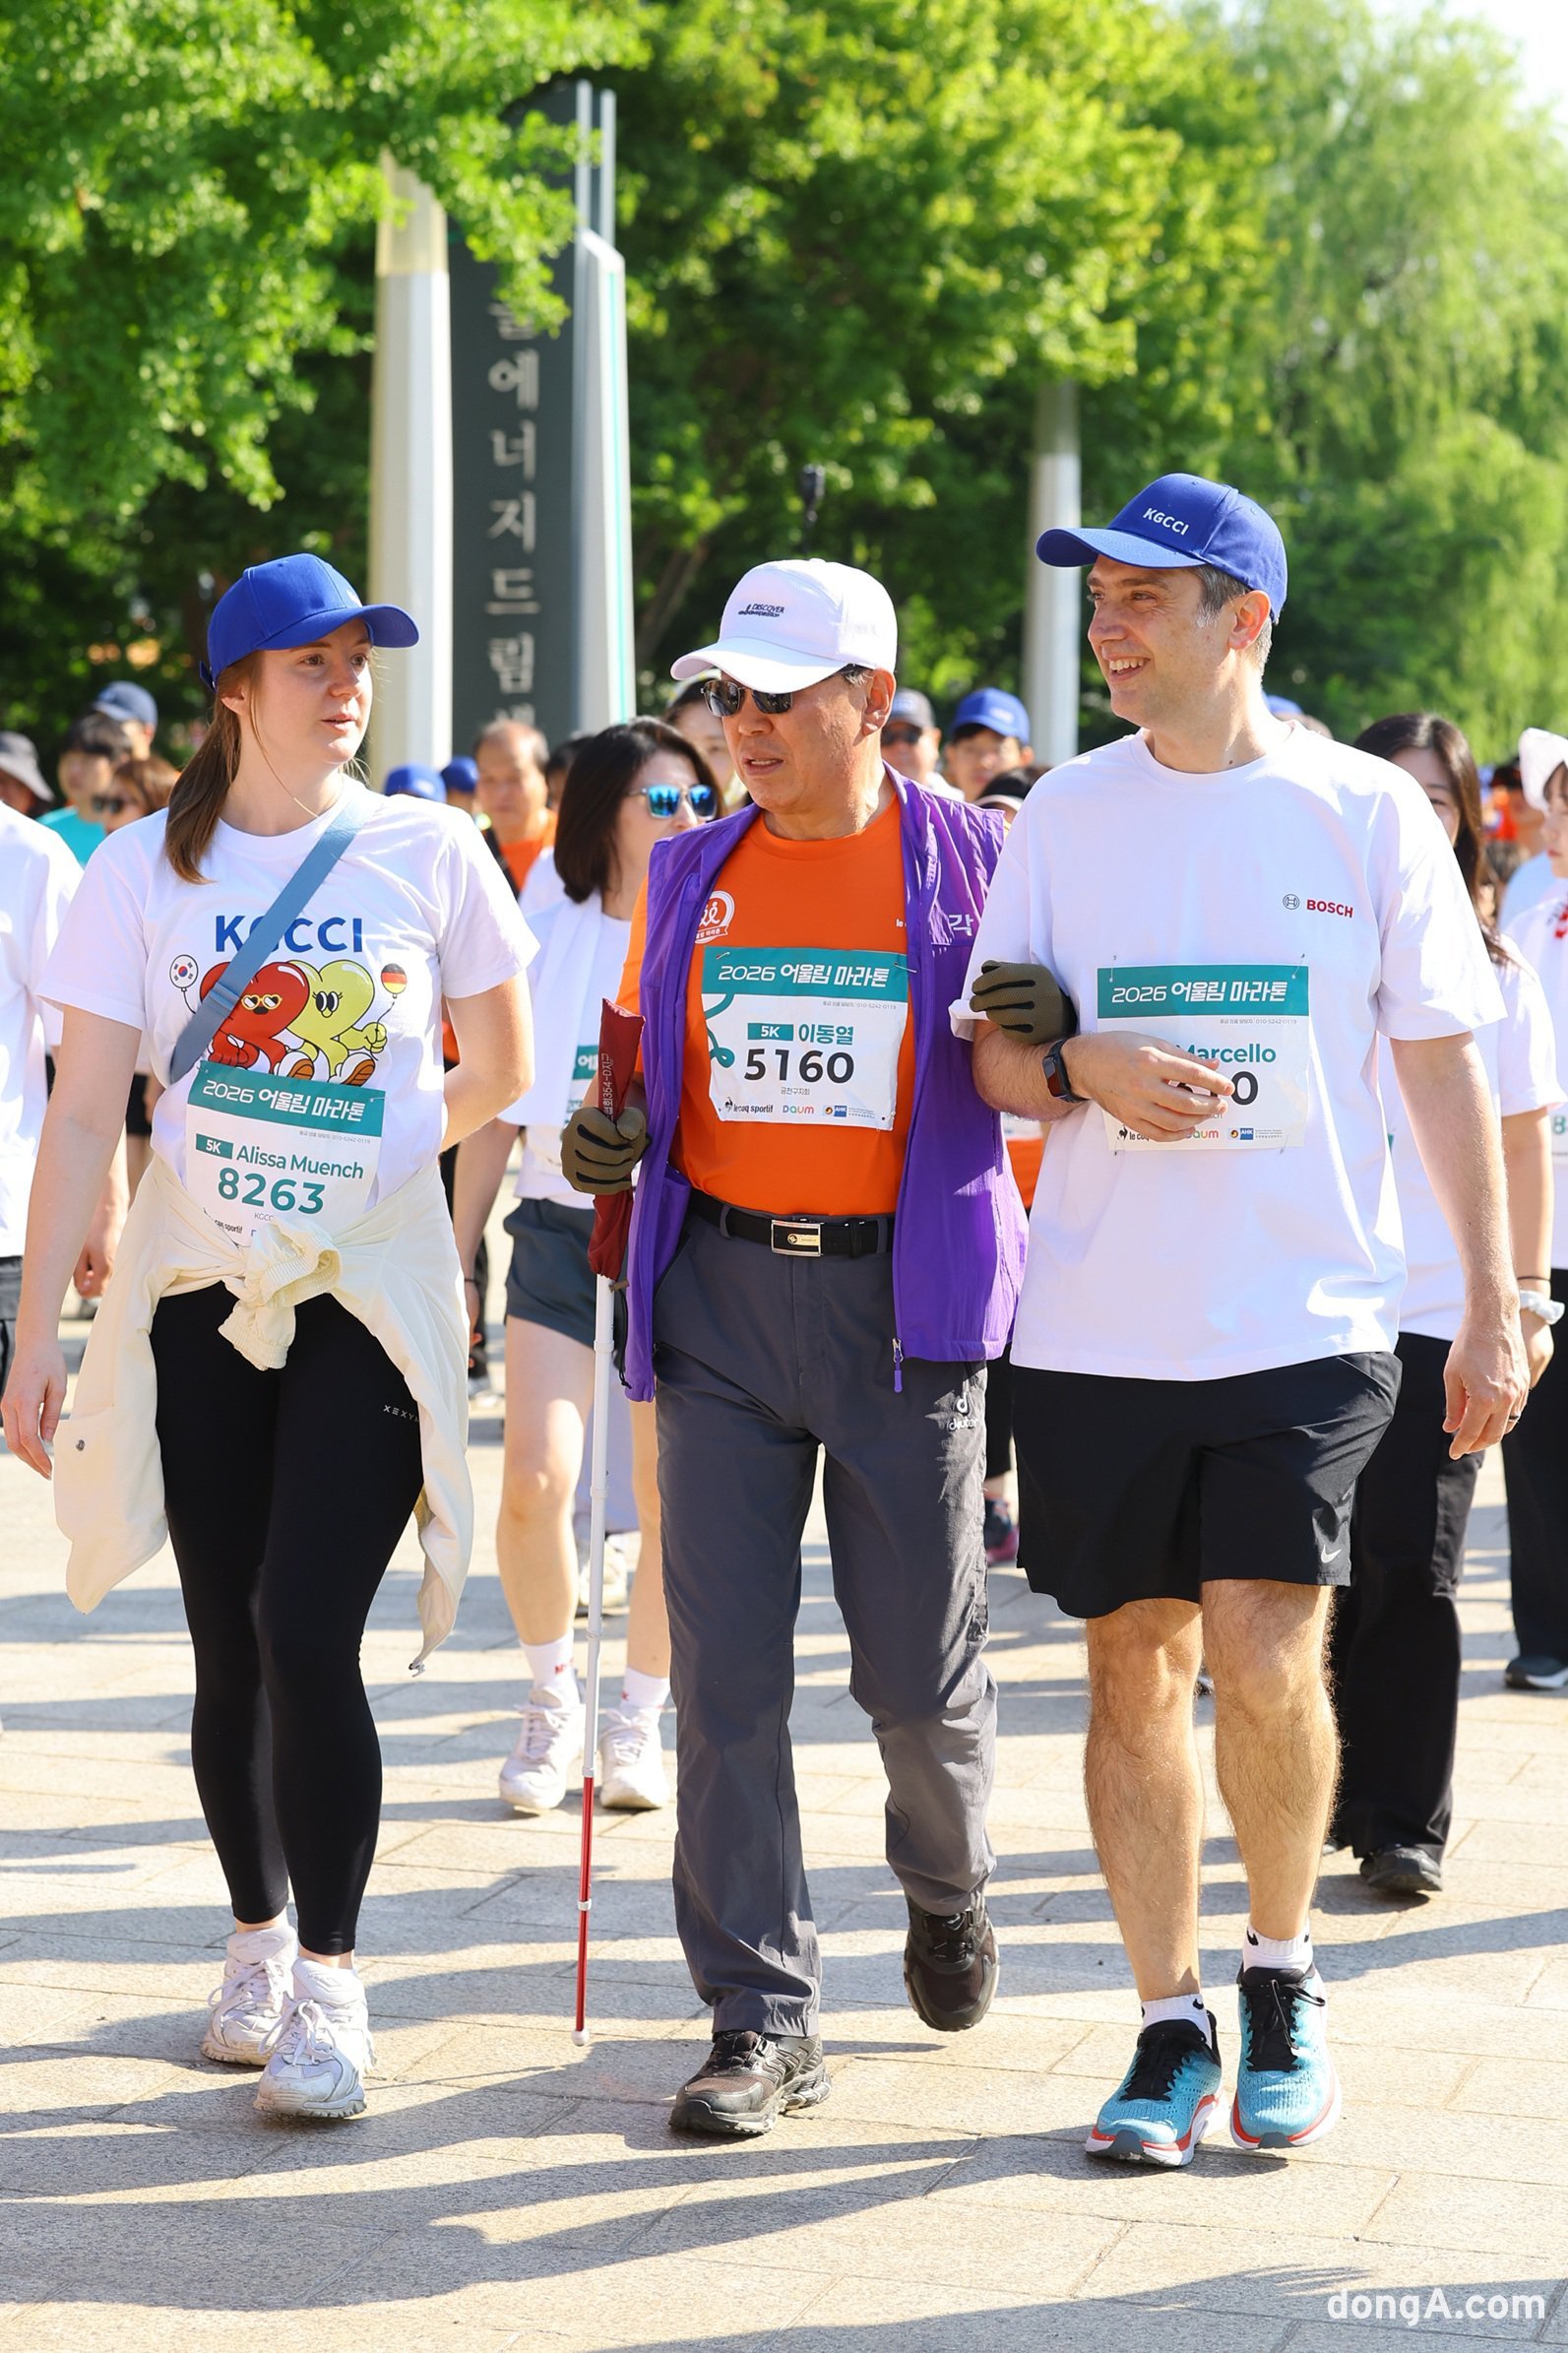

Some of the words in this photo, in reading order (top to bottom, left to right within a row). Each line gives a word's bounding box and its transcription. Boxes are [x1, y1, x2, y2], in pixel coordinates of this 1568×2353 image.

[1143, 507, 1189, 536] KGCCI
[1306, 899, 1353, 919] BOSCH
[718, 965, 776, 982] 2026
[780, 964, 833, 985] 어울림
[834, 966, 890, 988] 마라톤
[1111, 986, 1167, 1003] 2026
[1170, 981, 1226, 1002] 어울림
[1229, 982, 1288, 1002] 마라톤
[760, 1025, 780, 1038] 5K
[798, 1023, 854, 1046] 이동열
[743, 1049, 854, 1084] 5160
[203, 1079, 255, 1104] 2026
[258, 1088, 310, 1114] 어울림
[311, 1097, 365, 1122] 마라톤
[750, 1105, 774, 1113] sportif
[206, 1139, 221, 1154] 5K
[236, 1146, 286, 1170] Alissa
[290, 1154, 363, 1179] Muench
[218, 1167, 326, 1215] 8263
